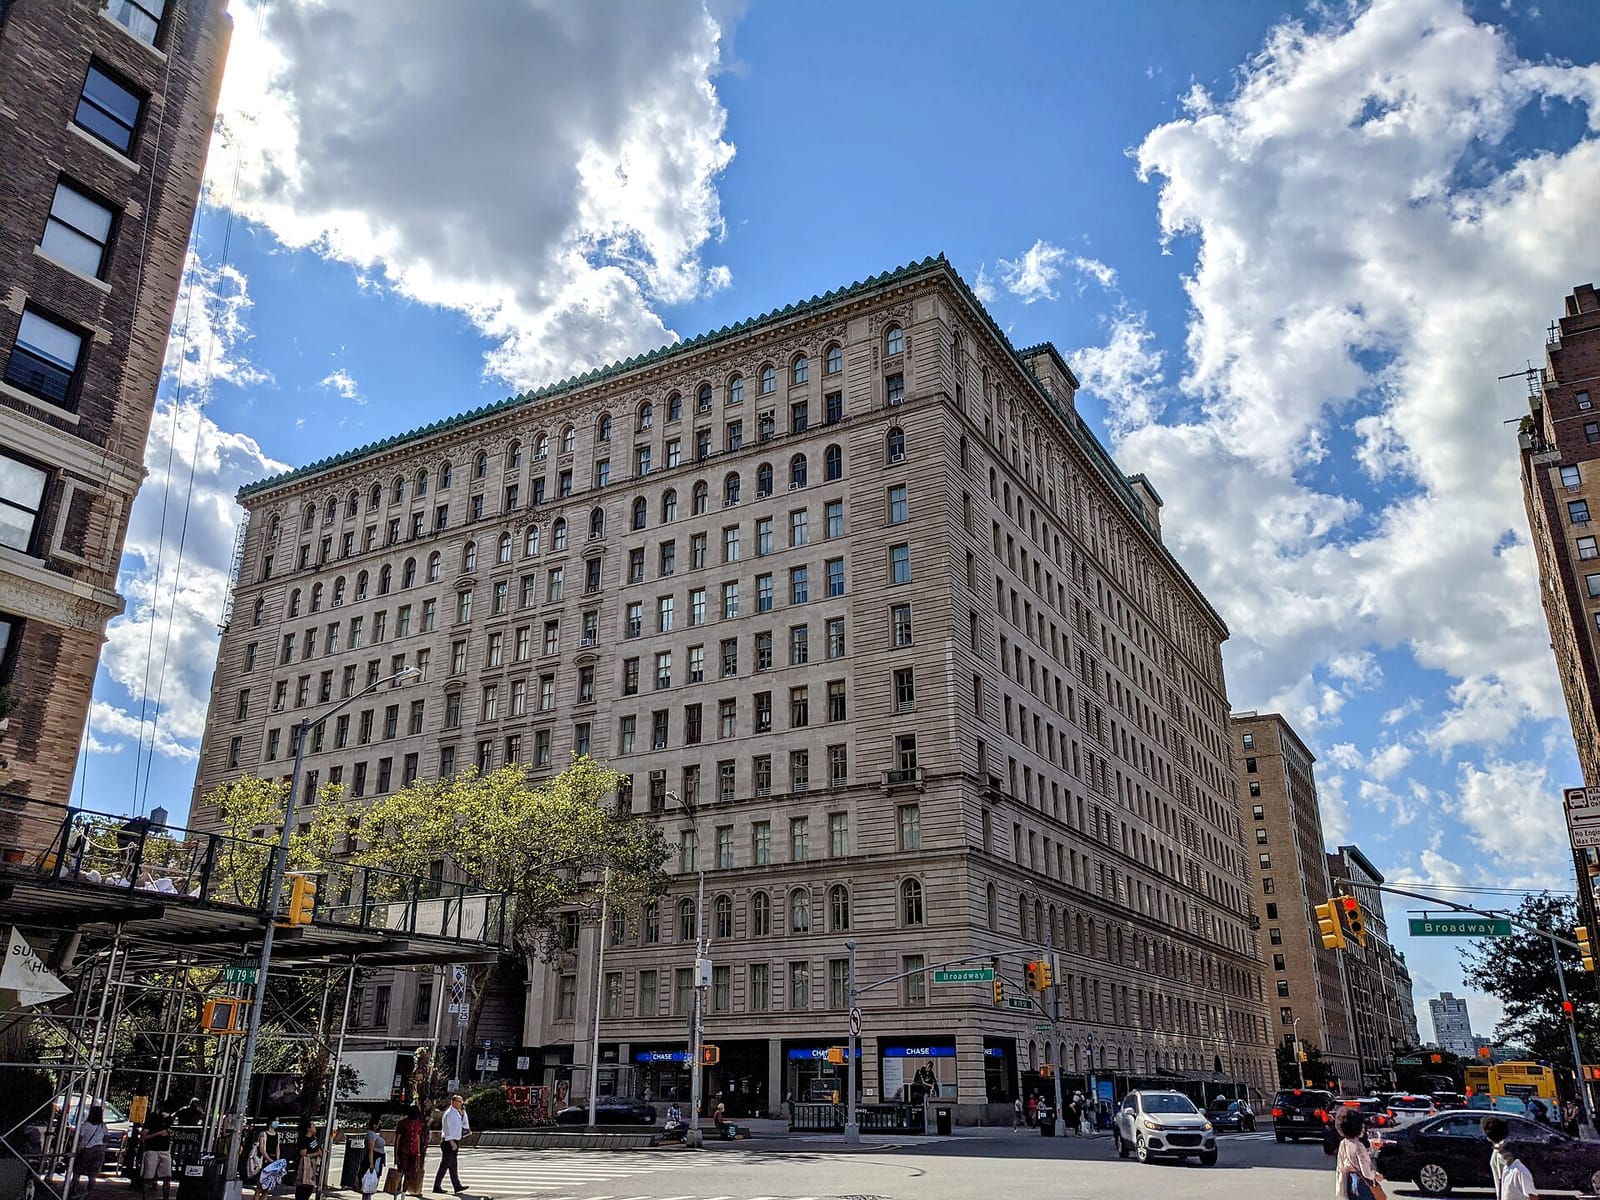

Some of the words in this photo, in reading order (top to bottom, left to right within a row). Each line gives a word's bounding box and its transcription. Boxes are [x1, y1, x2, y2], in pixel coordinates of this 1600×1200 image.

[1424, 923, 1495, 934] Broadway
[226, 969, 235, 980] W
[237, 969, 247, 981] 79
[249, 970, 256, 978] St
[943, 971, 985, 980] Broadway
